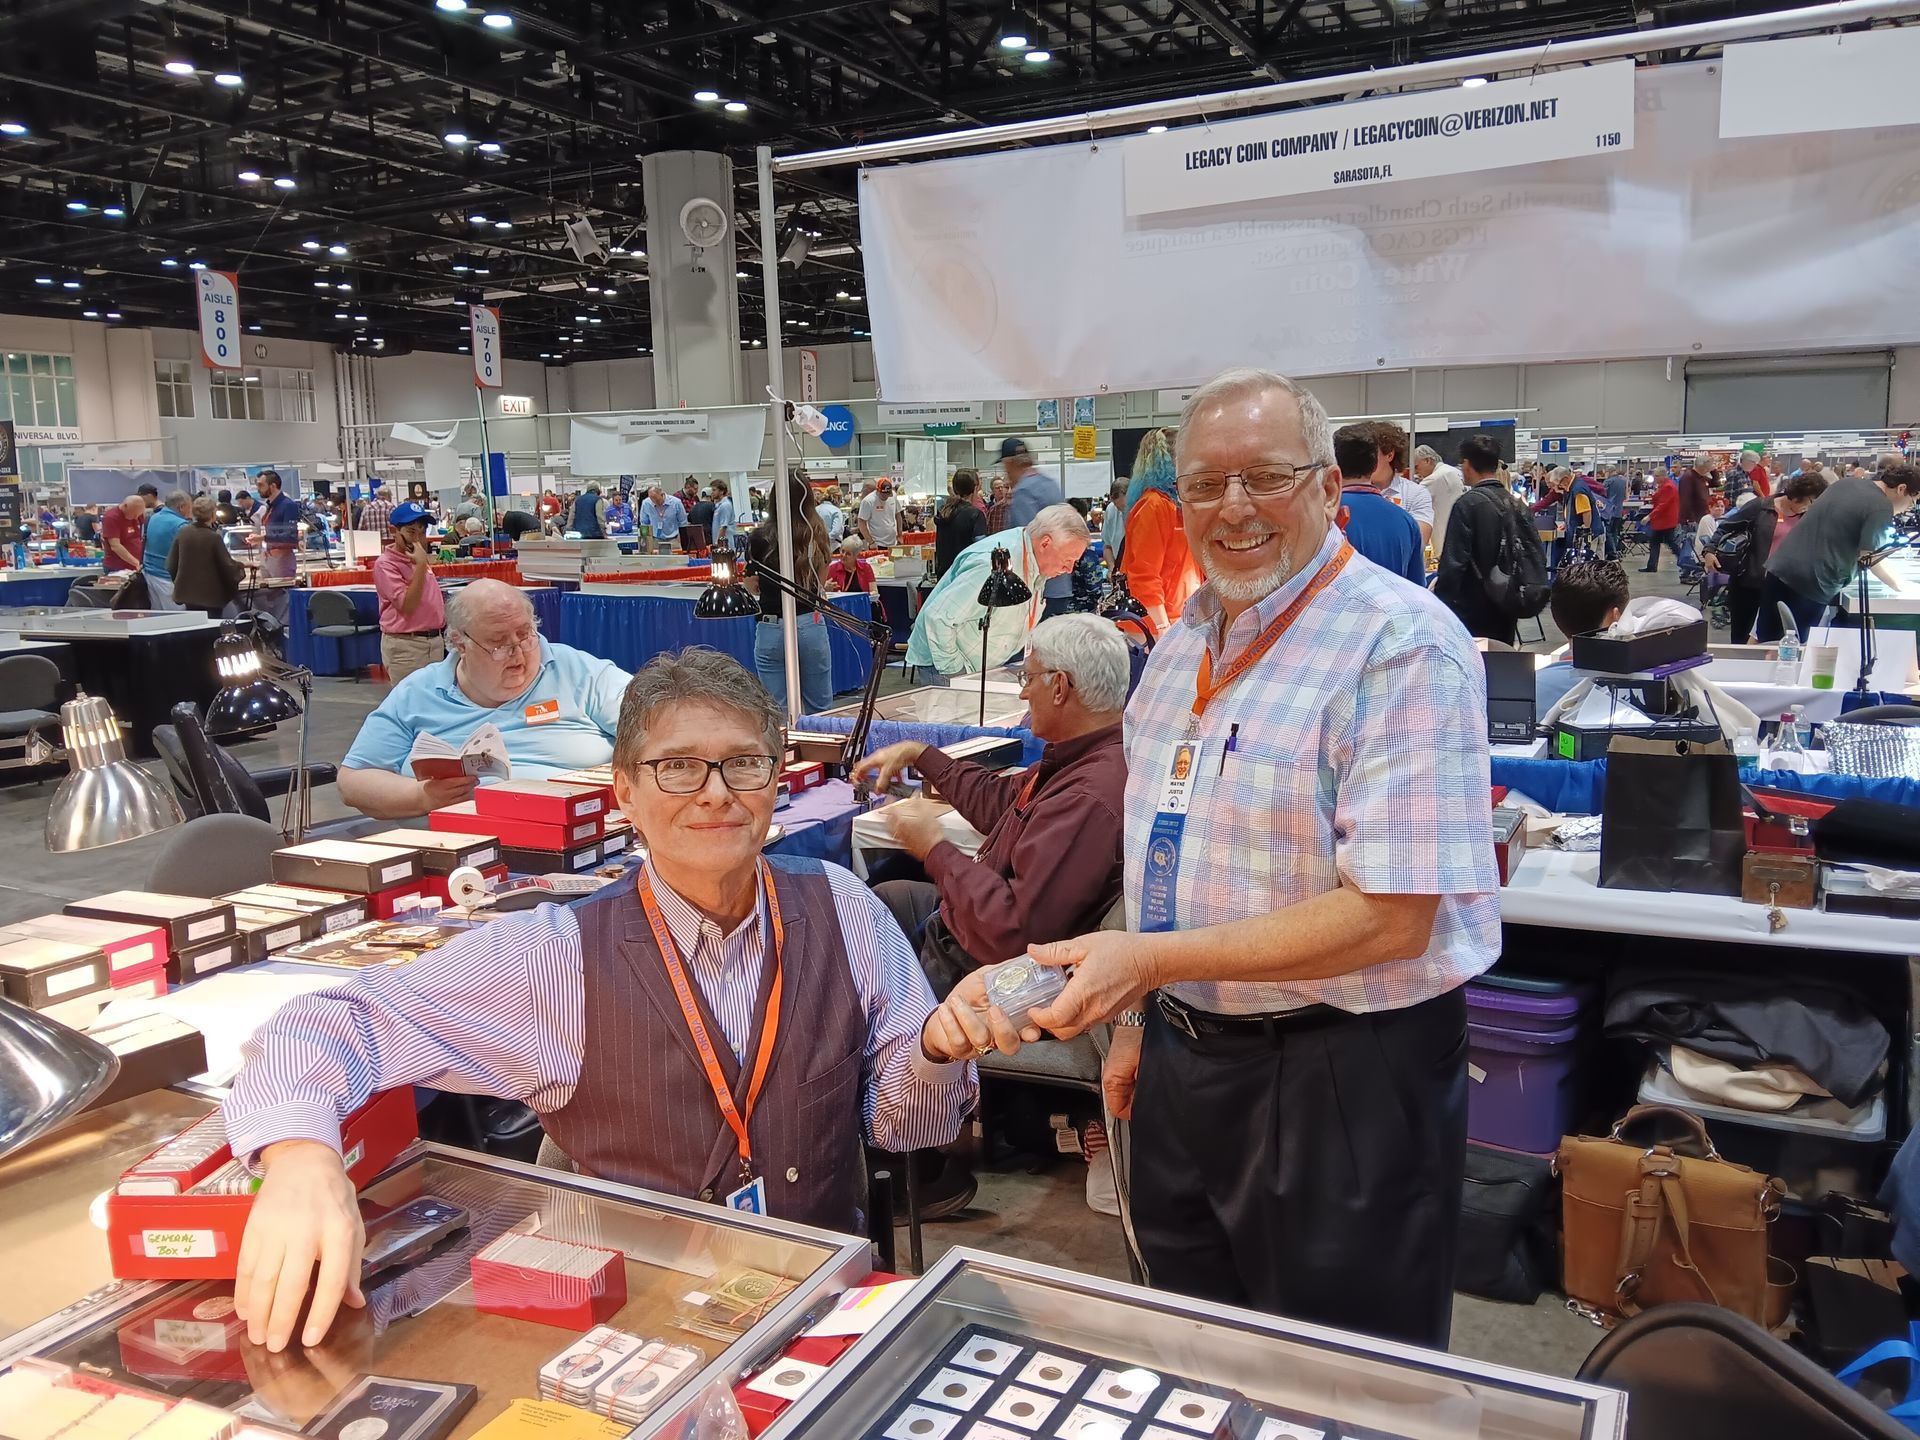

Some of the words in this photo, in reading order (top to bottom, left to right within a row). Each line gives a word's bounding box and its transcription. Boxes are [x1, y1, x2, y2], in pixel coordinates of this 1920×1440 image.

[1186, 146, 1232, 171] LEGACY
[1236, 141, 1268, 163] COIN
[1271, 130, 1339, 159] COMPANY
[1343, 128, 1349, 150] /
[1353, 98, 1559, 147] LEGACYCOIN@VERIZON.NET
[1595, 131, 1621, 148] 1150
[1333, 164, 1393, 184] SARASOTA,FL
[204, 293, 232, 305] AISLE
[215, 310, 227, 357] 800
[476, 325, 496, 335] AISLE
[483, 338, 492, 377] 700
[803, 364, 815, 372] AISLE
[503, 399, 527, 413] EXIT
[829, 421, 848, 431] NGC
[14, 432, 54, 440] NIVERSAL
[57, 432, 79, 440] BLVD.
[1312, 554, 1346, 590] FLORIDA
[647, 907, 682, 978] NUMISMATISTS
[676, 976, 699, 1018] UNITED
[691, 1016, 716, 1065] FLORIDA
[147, 1233, 197, 1244] GENERAL
